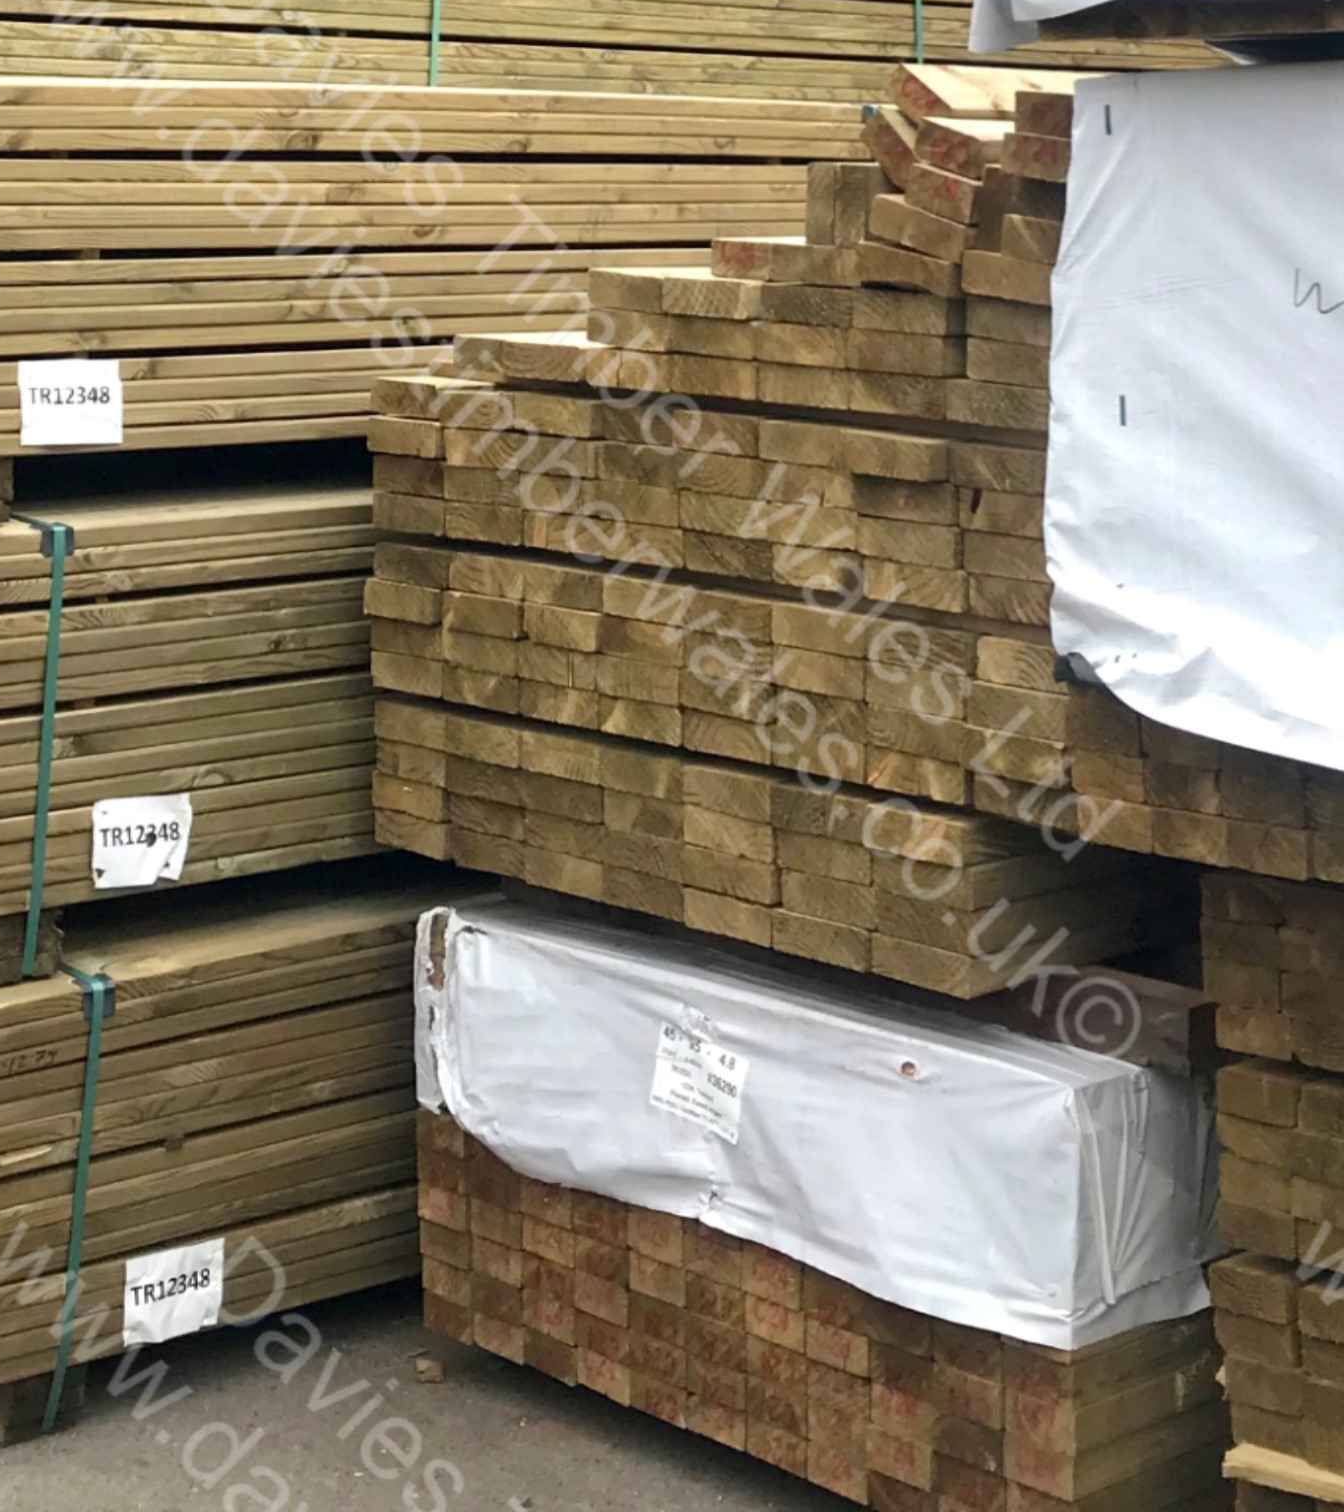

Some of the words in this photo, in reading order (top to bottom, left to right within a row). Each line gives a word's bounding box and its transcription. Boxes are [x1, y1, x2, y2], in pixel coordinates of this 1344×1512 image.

[28, 386, 110, 405] TR12348
[99, 821, 181, 847] TR12348
[130, 1268, 211, 1306] TR12348
